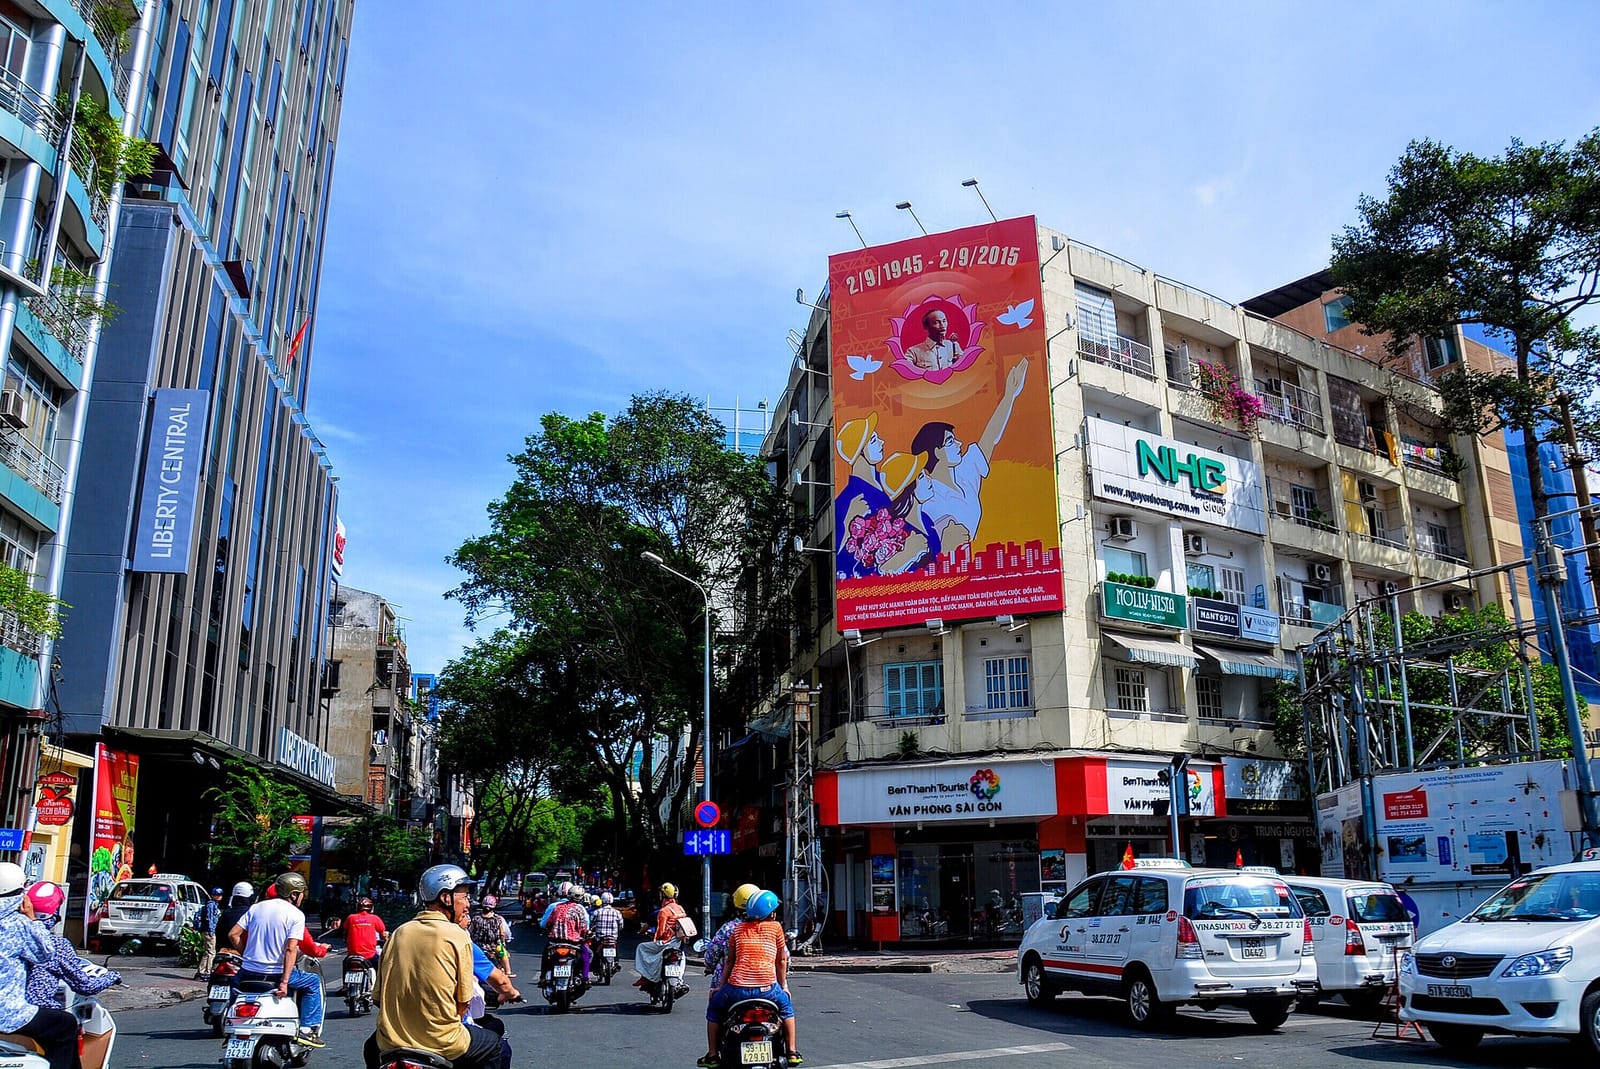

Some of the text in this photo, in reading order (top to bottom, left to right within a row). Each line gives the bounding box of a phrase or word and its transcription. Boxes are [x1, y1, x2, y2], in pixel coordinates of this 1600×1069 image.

[846, 254, 923, 296] 2/9/1945
[939, 245, 1021, 269] 2/9/2015
[1137, 439, 1227, 493] NHG
[151, 403, 191, 558] LIBERTY CENTRAL
[1104, 483, 1200, 515] www.nguyenhoang.com.vn
[1203, 501, 1226, 517] Group
[280, 726, 311, 775] LIBERTY
[937, 782, 968, 792] Tourist
[1255, 825, 1282, 837] TRUNG
[1262, 921, 1283, 929] 38.27
[1284, 921, 1293, 929] 27
[1091, 934, 1121, 944] 38.27 27 27
[1244, 948, 1264, 957] 0442
[743, 1052, 771, 1064] 429.61
